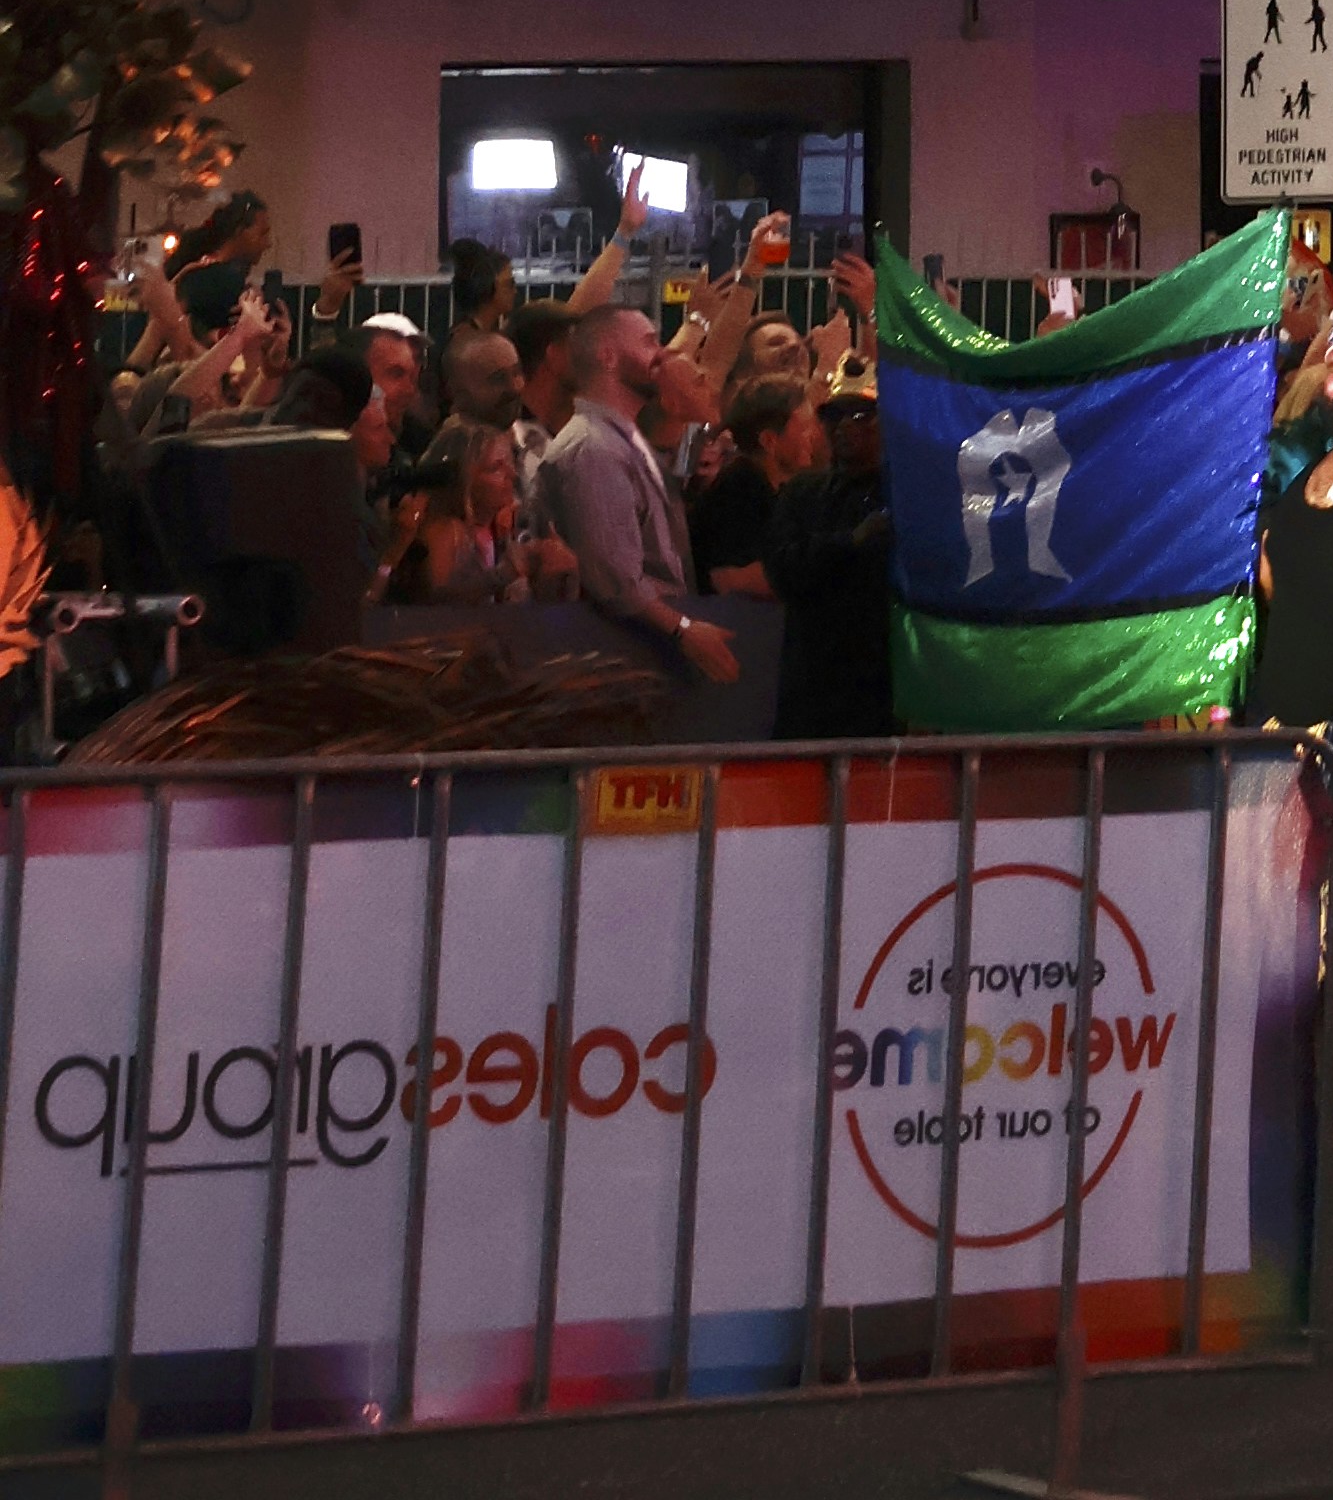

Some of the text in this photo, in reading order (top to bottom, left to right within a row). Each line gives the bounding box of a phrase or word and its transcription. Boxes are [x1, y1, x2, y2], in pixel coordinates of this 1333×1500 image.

[1265, 127, 1299, 143] HIGH
[1238, 148, 1326, 165] PEDESTRIAN
[1251, 168, 1313, 186] ACTIVITY
